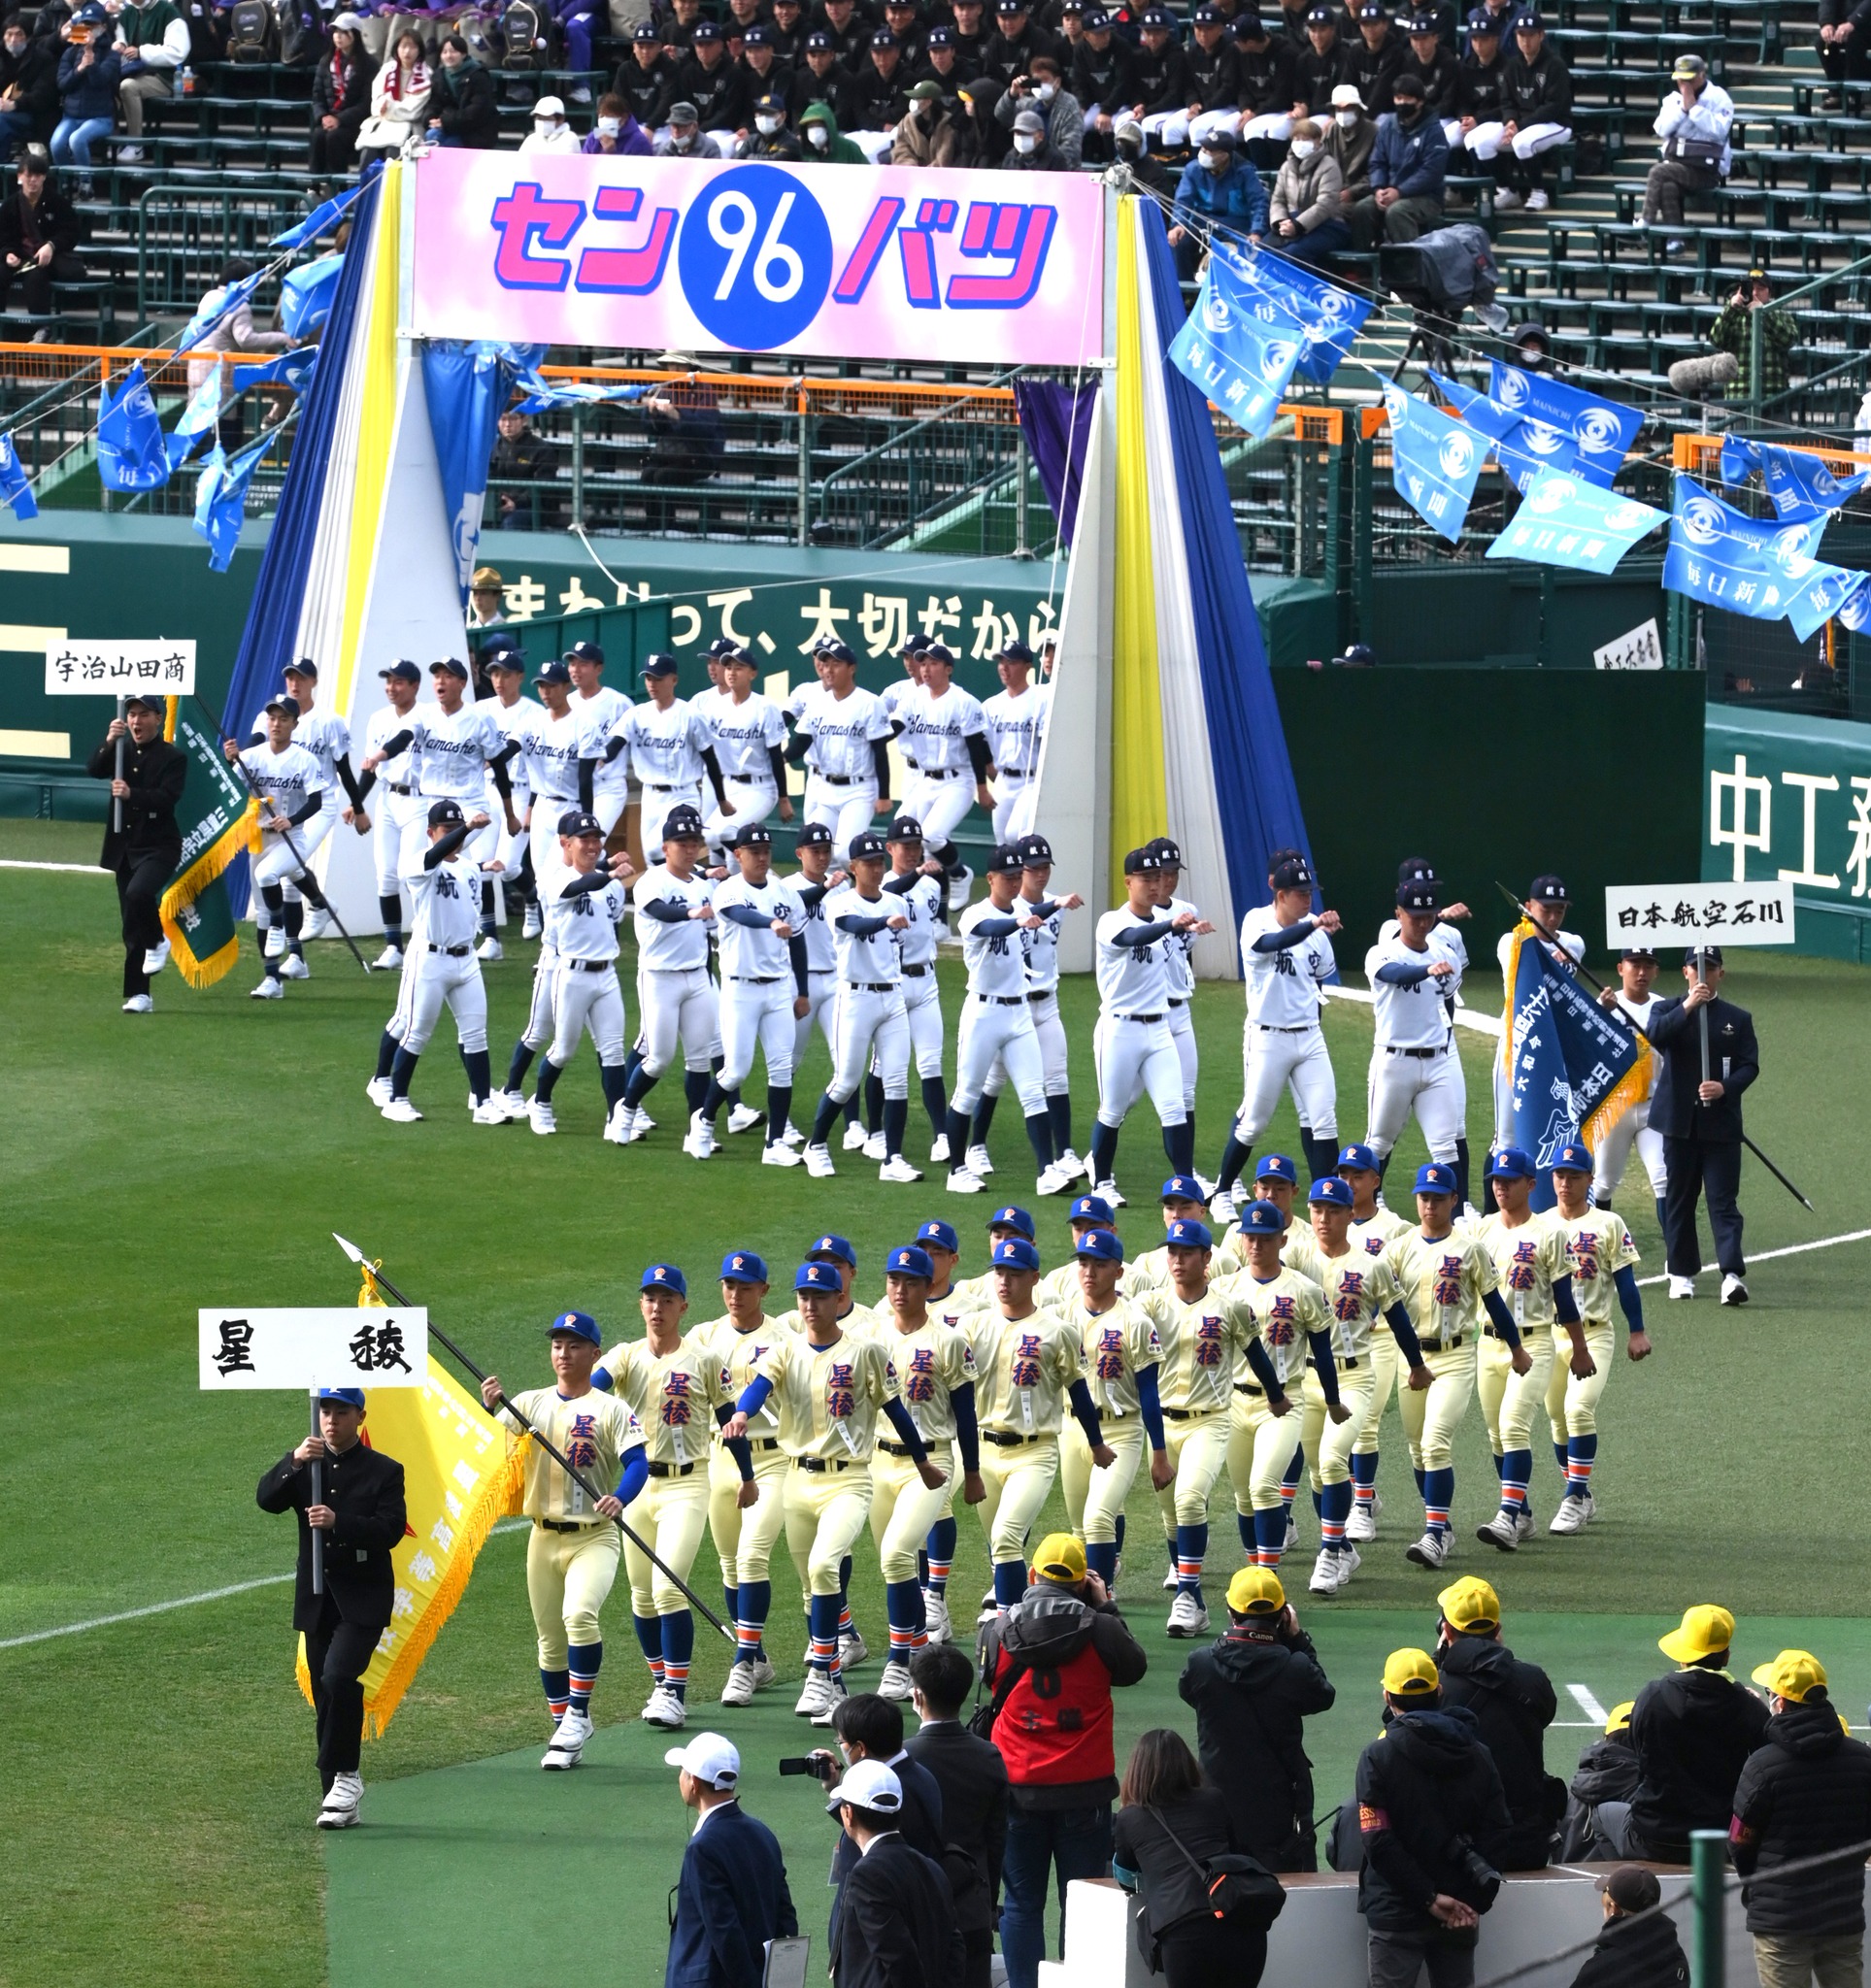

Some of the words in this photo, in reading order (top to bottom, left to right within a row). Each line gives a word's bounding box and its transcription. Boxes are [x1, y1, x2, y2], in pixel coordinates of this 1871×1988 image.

[490, 182, 679, 295] セン
[707, 189, 804, 304] 96
[832, 196, 1058, 310] バツ
[55, 650, 186, 682] 宇治山田商
[908, 713, 961, 737] Yamasho
[1618, 899, 1785, 929] 日本航空石川
[1275, 949, 1322, 977] 航空
[1435, 1254, 1462, 1306] 星稜
[1509, 1241, 1537, 1290] 星稜
[1267, 1295, 1295, 1346] 星稜
[1335, 1270, 1363, 1321] 星稜
[1013, 1334, 1042, 1387] 星稜
[1097, 1328, 1124, 1379] 星稜
[1196, 1315, 1222, 1367] 星稜
[661, 1371, 691, 1427] 星稜
[827, 1363, 855, 1418] 星稜
[907, 1348, 935, 1402] 星稜
[566, 1413, 597, 1469] 星稜
[1248, 1631, 1274, 1642] Canon
